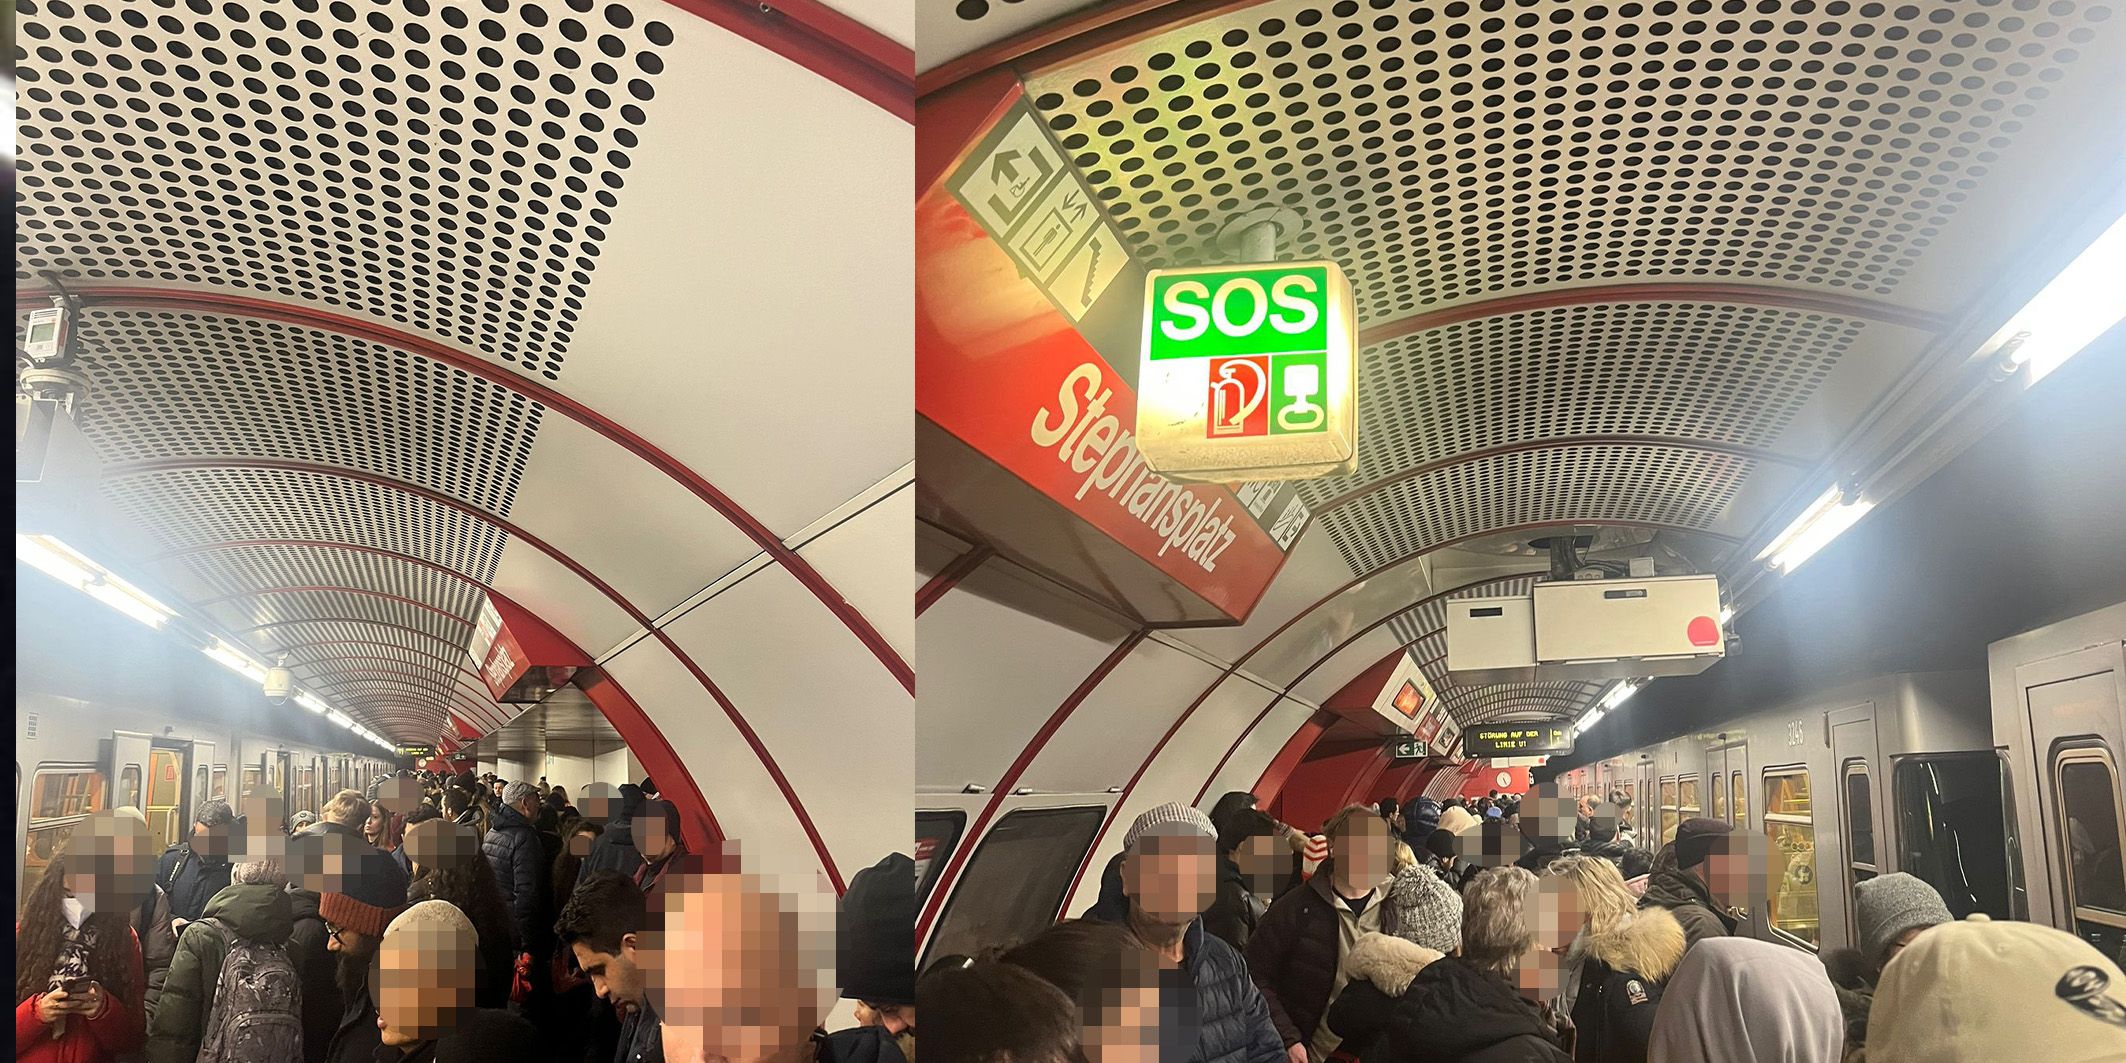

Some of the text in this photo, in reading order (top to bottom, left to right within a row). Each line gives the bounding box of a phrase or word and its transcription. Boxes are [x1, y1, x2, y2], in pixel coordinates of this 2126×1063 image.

[1160, 275, 1319, 341] SOS
[1031, 363, 1237, 573] Stephansplatz
[1495, 741, 1516, 749] LINIE
